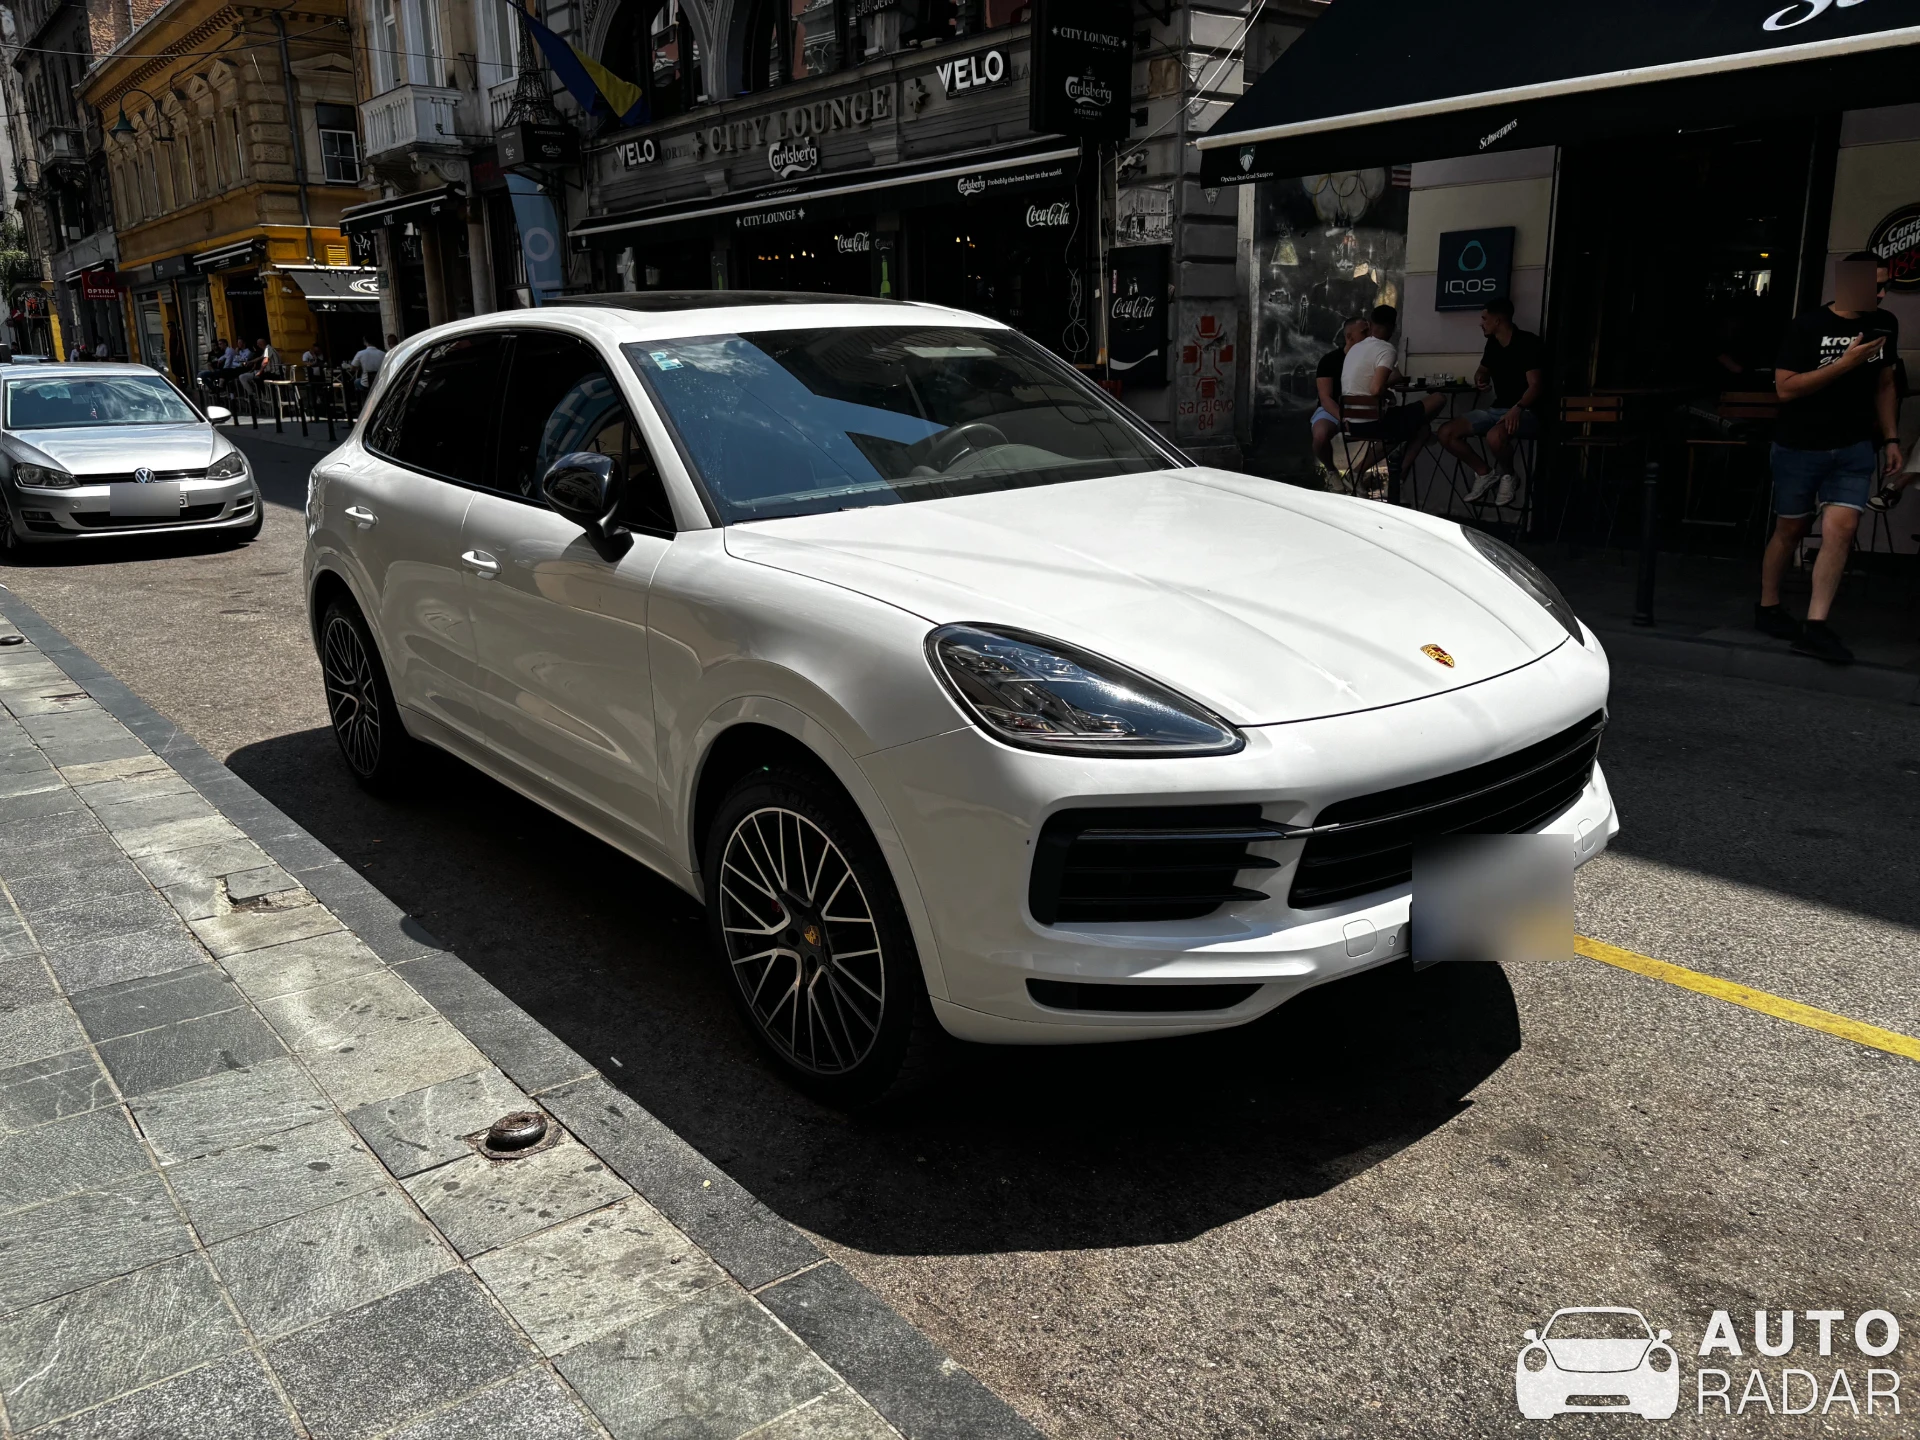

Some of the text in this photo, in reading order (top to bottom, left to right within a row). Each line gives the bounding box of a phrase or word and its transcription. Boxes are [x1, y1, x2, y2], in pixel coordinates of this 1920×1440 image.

[1060, 26, 1120, 47] CITY LOUNGE
[935, 50, 1004, 92] VELO
[1065, 75, 1112, 107] Carlsberg
[710, 85, 892, 155] CITY LOUNGE
[1073, 107, 1103, 117] DENMARK
[1479, 118, 1518, 150] Schweppes
[616, 139, 656, 167] VELO
[768, 137, 818, 179] Carlsberg
[957, 176, 985, 196] Carlsberg
[743, 210, 797, 226] CITY LOUNGE
[1026, 200, 1071, 228] Coca-Cola
[837, 231, 871, 254] Coca-Cola
[1445, 277, 1497, 295] IQOS
[1111, 296, 1156, 318] Coca-Cola
[1179, 399, 1234, 415] sarajevo
[1198, 413, 1214, 430] 84
